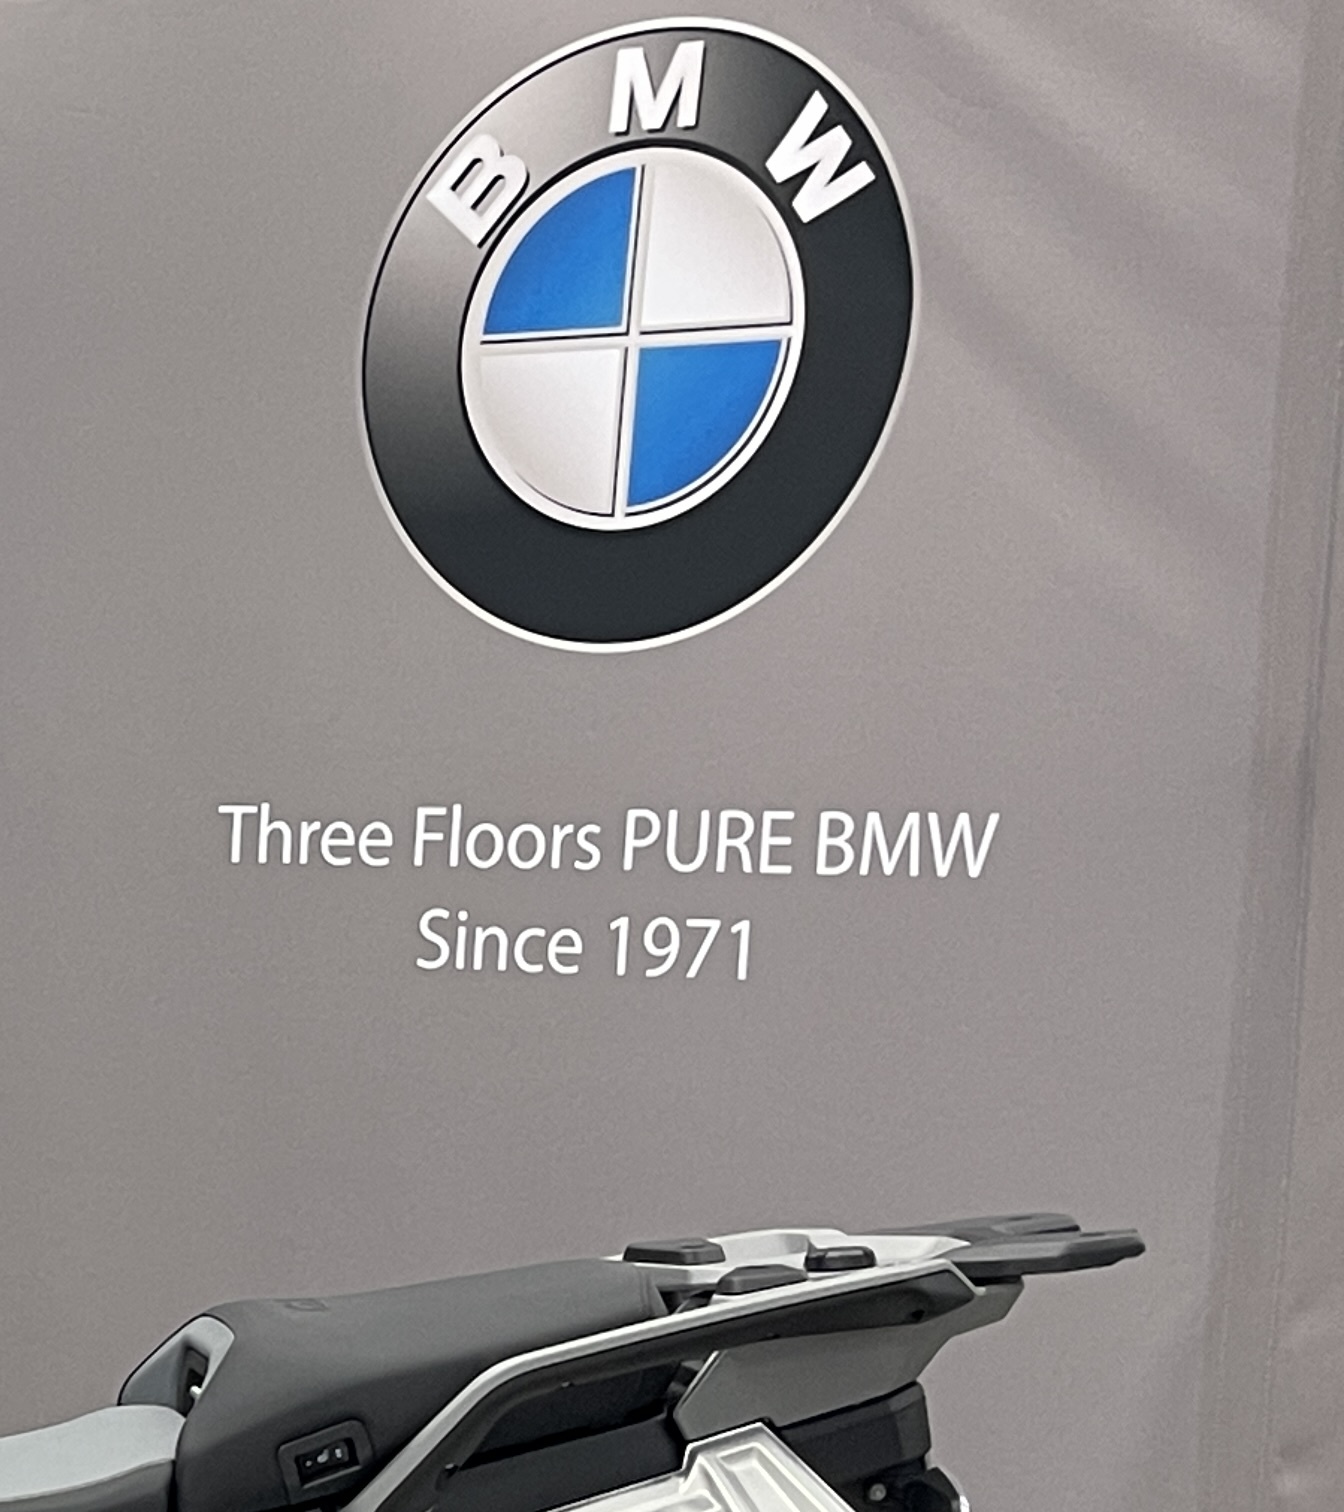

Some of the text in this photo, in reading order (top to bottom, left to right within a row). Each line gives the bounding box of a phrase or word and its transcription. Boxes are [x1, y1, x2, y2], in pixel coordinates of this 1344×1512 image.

[425, 40, 877, 249] BMW
[218, 802, 1000, 878] Three Floors PURE BMW
[416, 908, 750, 981] Since 1971
